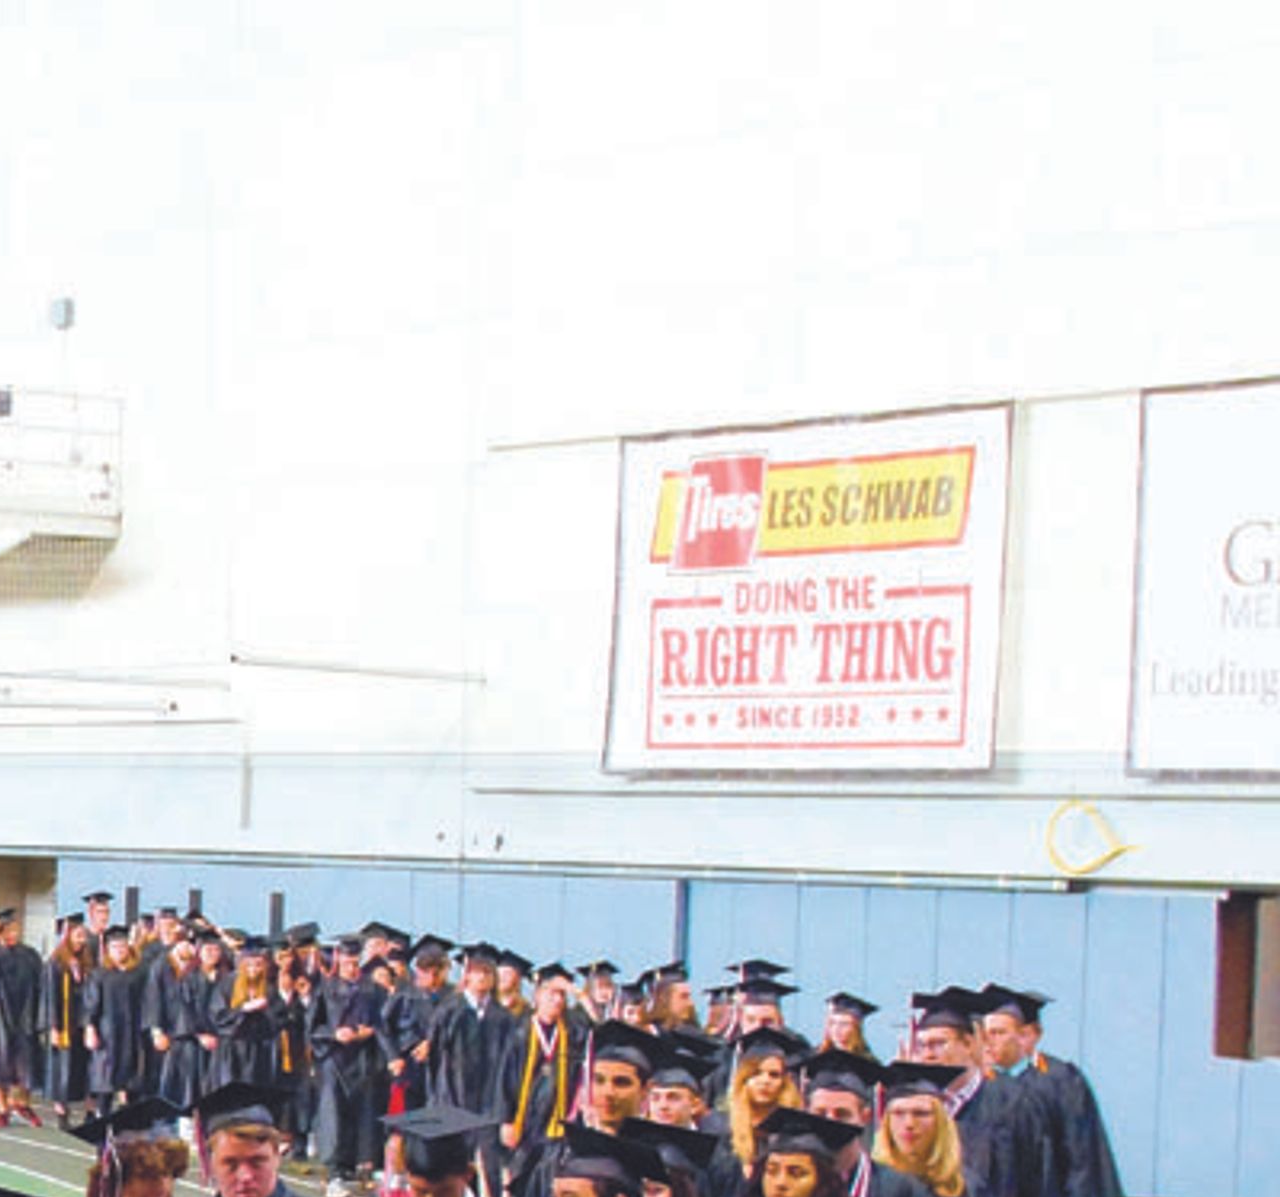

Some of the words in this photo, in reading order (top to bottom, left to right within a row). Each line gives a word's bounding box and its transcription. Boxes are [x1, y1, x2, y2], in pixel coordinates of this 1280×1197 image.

[767, 486, 815, 530] LES
[820, 475, 956, 527] SCHWAB
[1222, 520, 1280, 588] G
[735, 579, 818, 615] DOING
[825, 576, 876, 610] THE
[1220, 593, 1280, 629] ME
[661, 624, 796, 687] RIGHT
[813, 617, 955, 682] THING
[1152, 658, 1280, 706] Leading
[736, 706, 802, 728] SINCE
[812, 704, 860, 728] 1952
